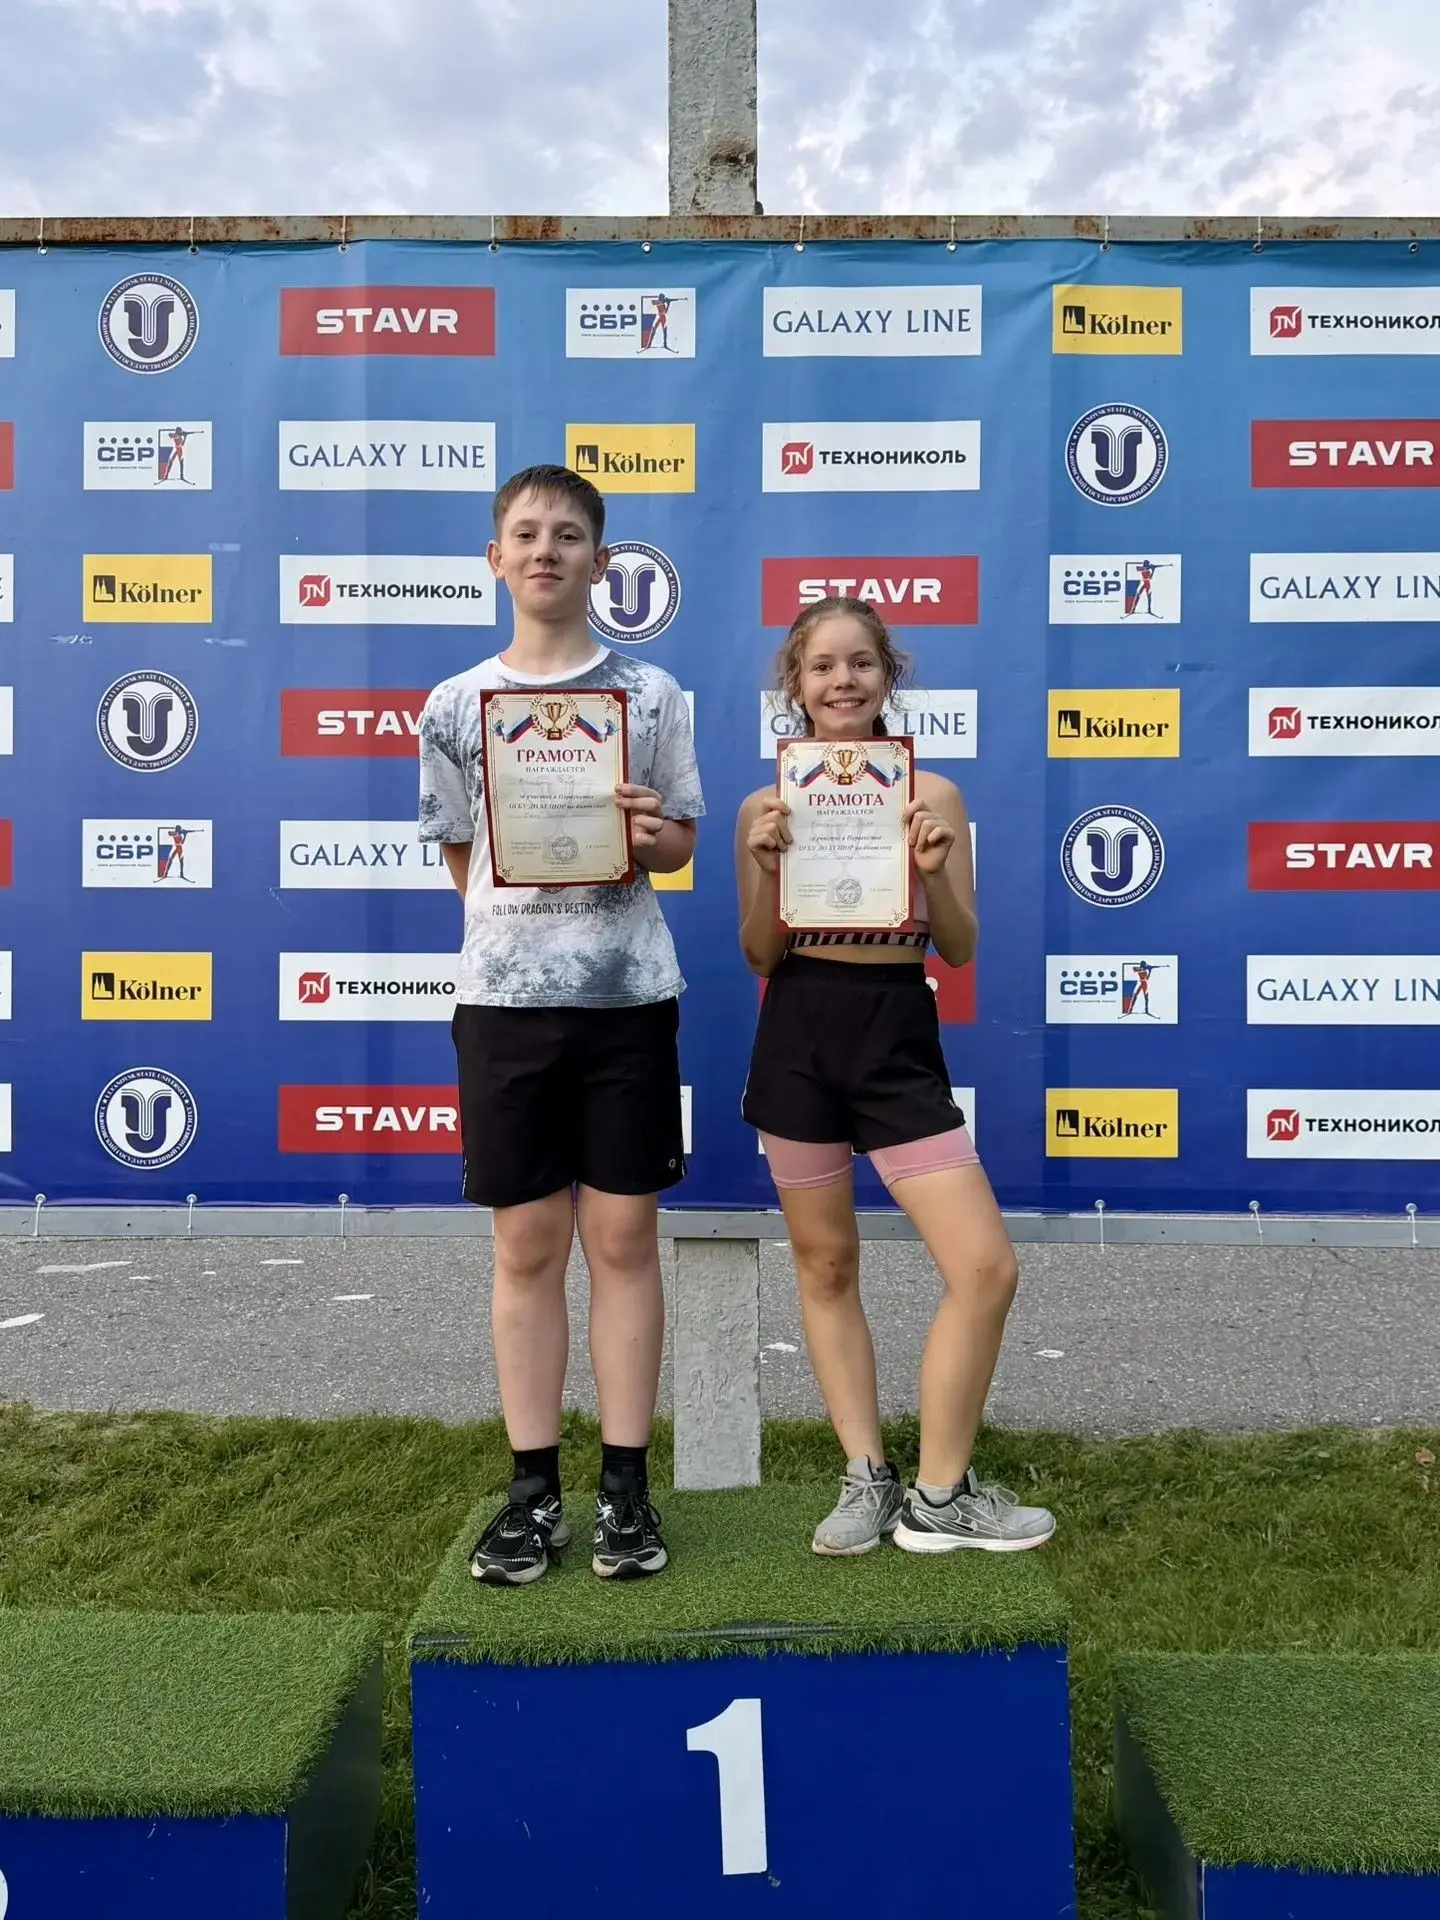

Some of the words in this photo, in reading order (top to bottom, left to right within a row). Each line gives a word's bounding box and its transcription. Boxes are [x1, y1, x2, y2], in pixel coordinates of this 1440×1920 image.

[317, 308, 458, 333] STAVR
[580, 314, 637, 329] СБР
[773, 310, 892, 333] GALAXY
[908, 309, 971, 332] LINE
[1089, 314, 1172, 334] Kölner
[1308, 315, 1440, 328] ТЕХНОНИКОЛ
[98, 447, 154, 461] СБР
[289, 444, 406, 467] GALAXY
[422, 445, 485, 468] LINE
[604, 453, 685, 473] Kölner
[819, 450, 966, 464] ТЕХНОНИКОЛЬ
[1289, 441, 1433, 465] STAVR
[120, 583, 201, 603] Kölner
[336, 584, 482, 598] ТЕХНОНИКОЛЬ
[799, 578, 941, 603] STAVR
[1064, 581, 1121, 595] СБР
[1260, 576, 1381, 599] GALAXY
[1397, 576, 1440, 598] LIN
[317, 710, 423, 735] STAV
[904, 712, 967, 735] LINE
[1086, 718, 1169, 737] Kölner
[1307, 716, 1440, 729] ТЕХНОНИКОЛ
[517, 749, 597, 763] ГРАМОТА
[809, 793, 884, 806] ГРАМОТА
[97, 845, 153, 859] СБР
[290, 844, 407, 866] GALAXY
[423, 843, 444, 866] LI
[1286, 843, 1432, 868] STAVR
[493, 904, 519, 916] FOLLOW
[521, 903, 562, 915] DRAGON'S
[565, 902, 600, 914] DESTINY
[120, 980, 201, 1000] Kölner
[336, 982, 455, 994] ТЕХНОНИКО
[1060, 981, 1118, 995] СБР
[1258, 979, 1379, 1001] GALAXY
[1395, 979, 1440, 1001] LIN
[316, 1107, 457, 1131] STAVR
[1084, 1117, 1167, 1137] Kölner
[1306, 1119, 1440, 1132] ТЕХНОНИКОЛ
[687, 1699, 767, 1875] 1
